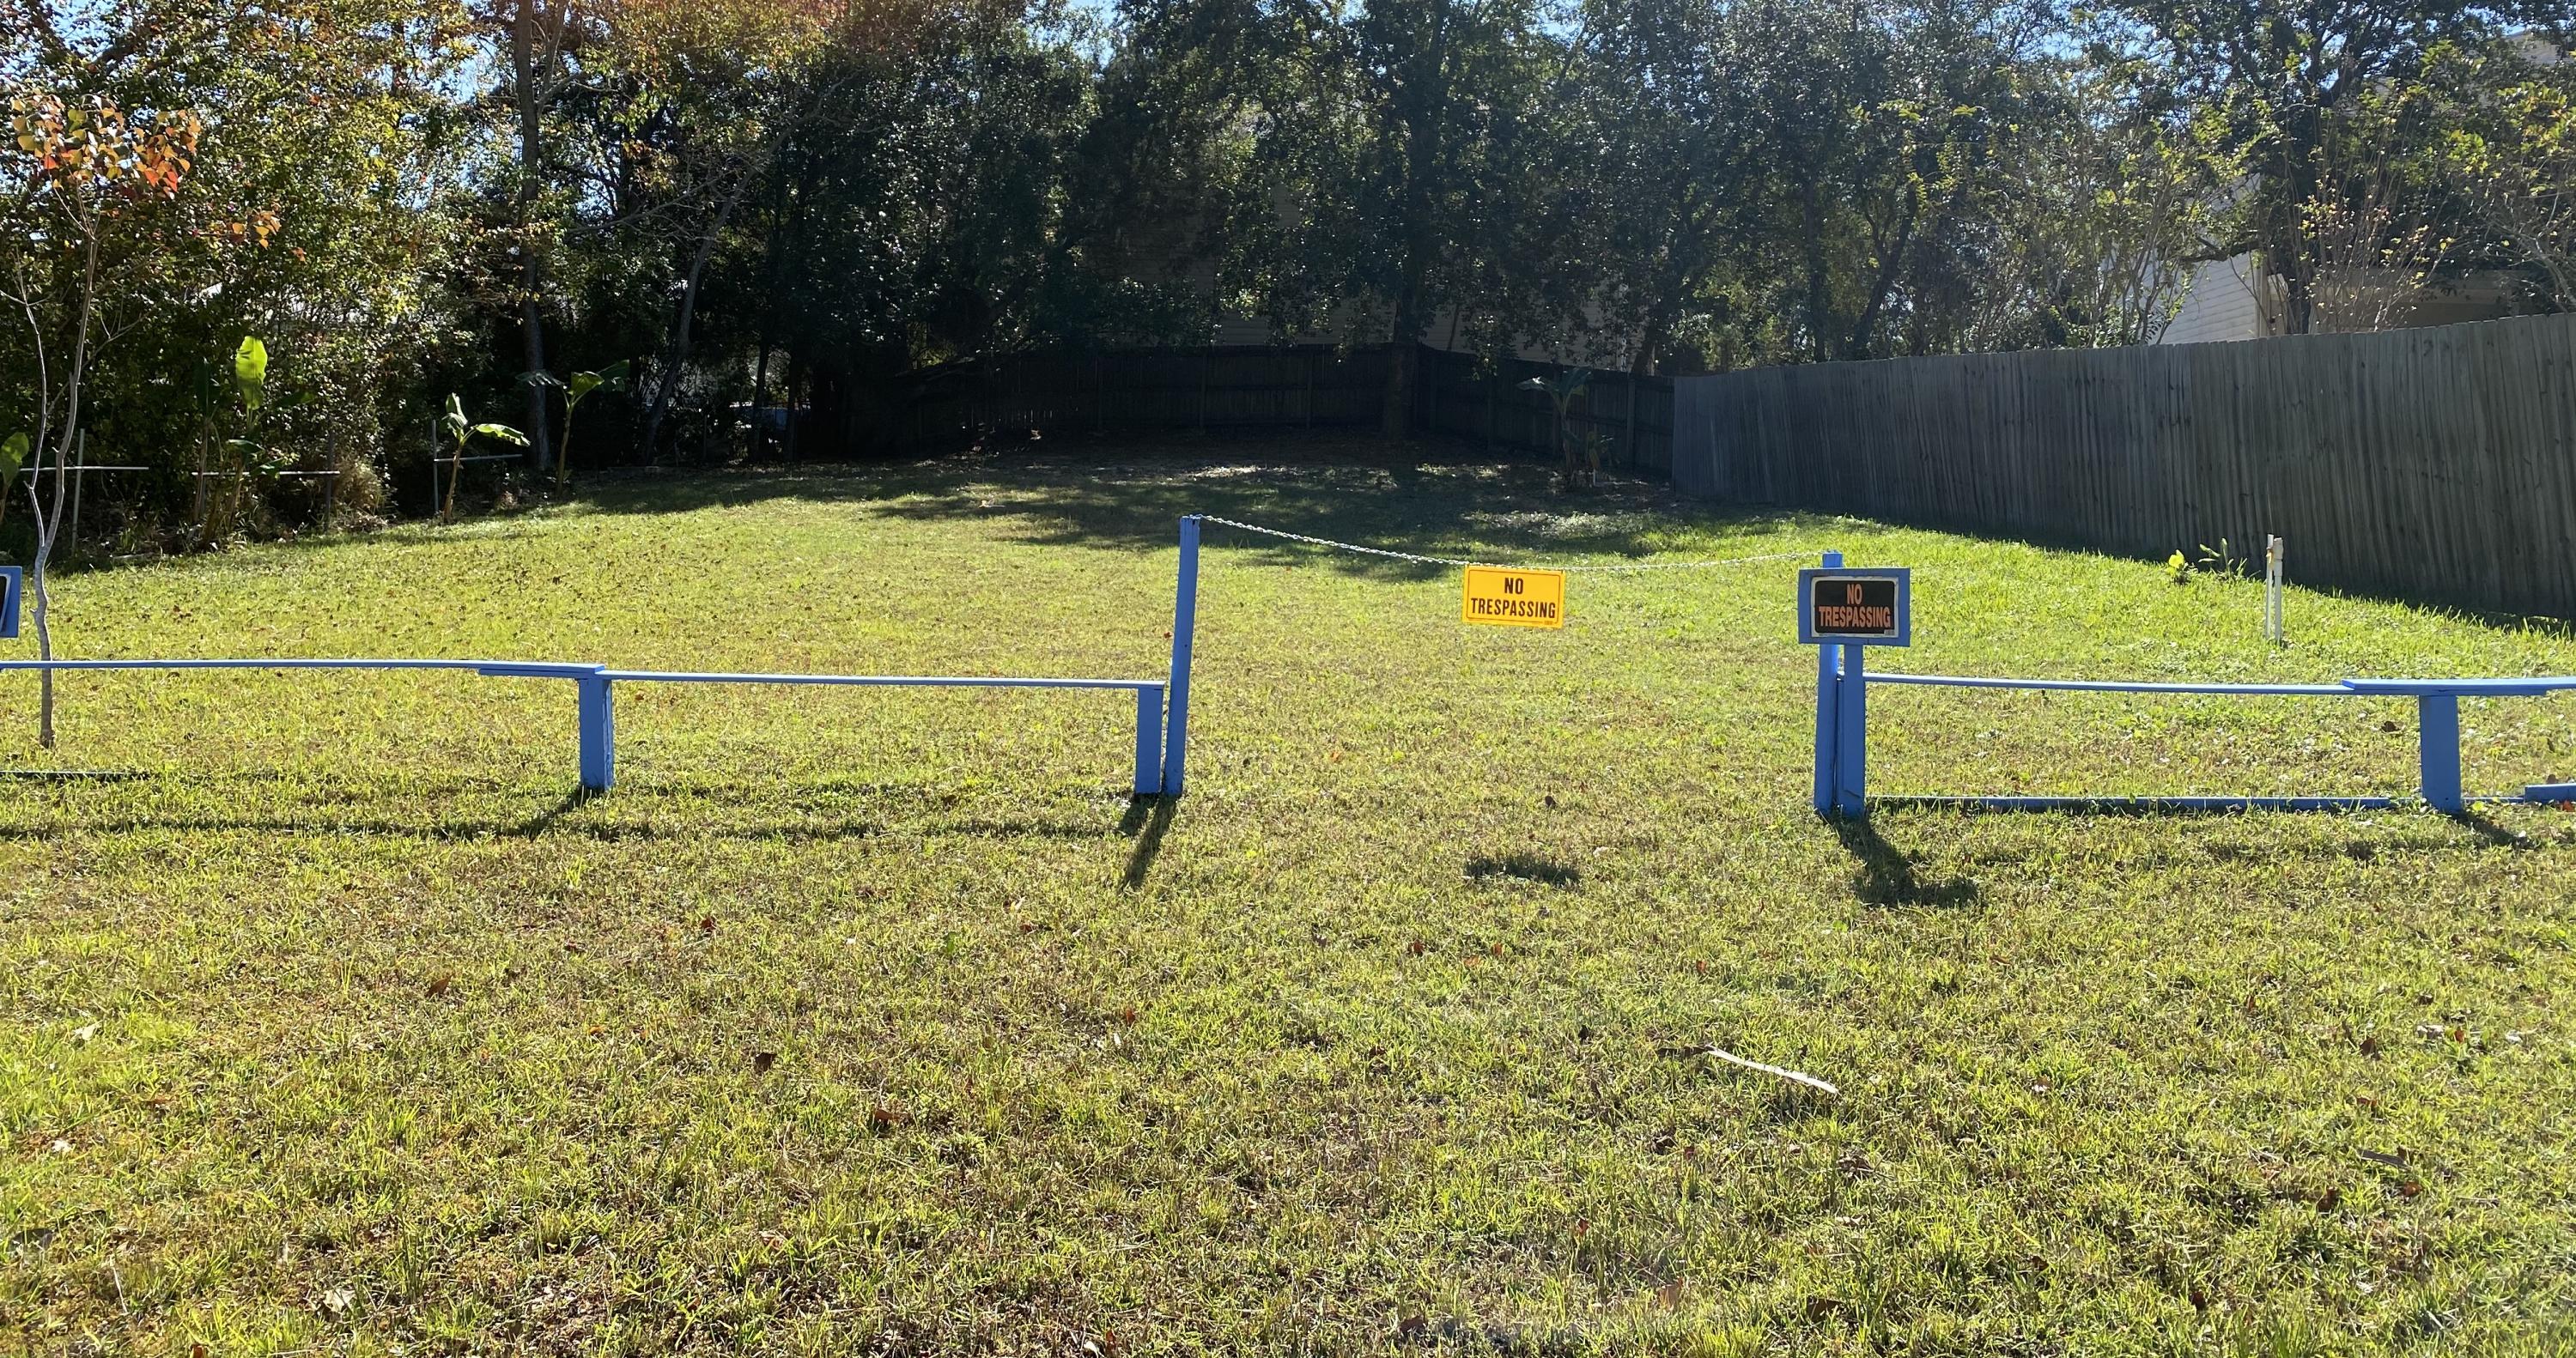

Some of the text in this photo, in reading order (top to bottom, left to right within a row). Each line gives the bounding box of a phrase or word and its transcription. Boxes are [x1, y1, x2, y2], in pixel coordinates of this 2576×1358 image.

[1504, 578, 1524, 594] NO
[1847, 584, 1862, 604] NO
[1471, 597, 1556, 618] TRESPASSING
[1819, 606, 1891, 627] TRESPASSING
